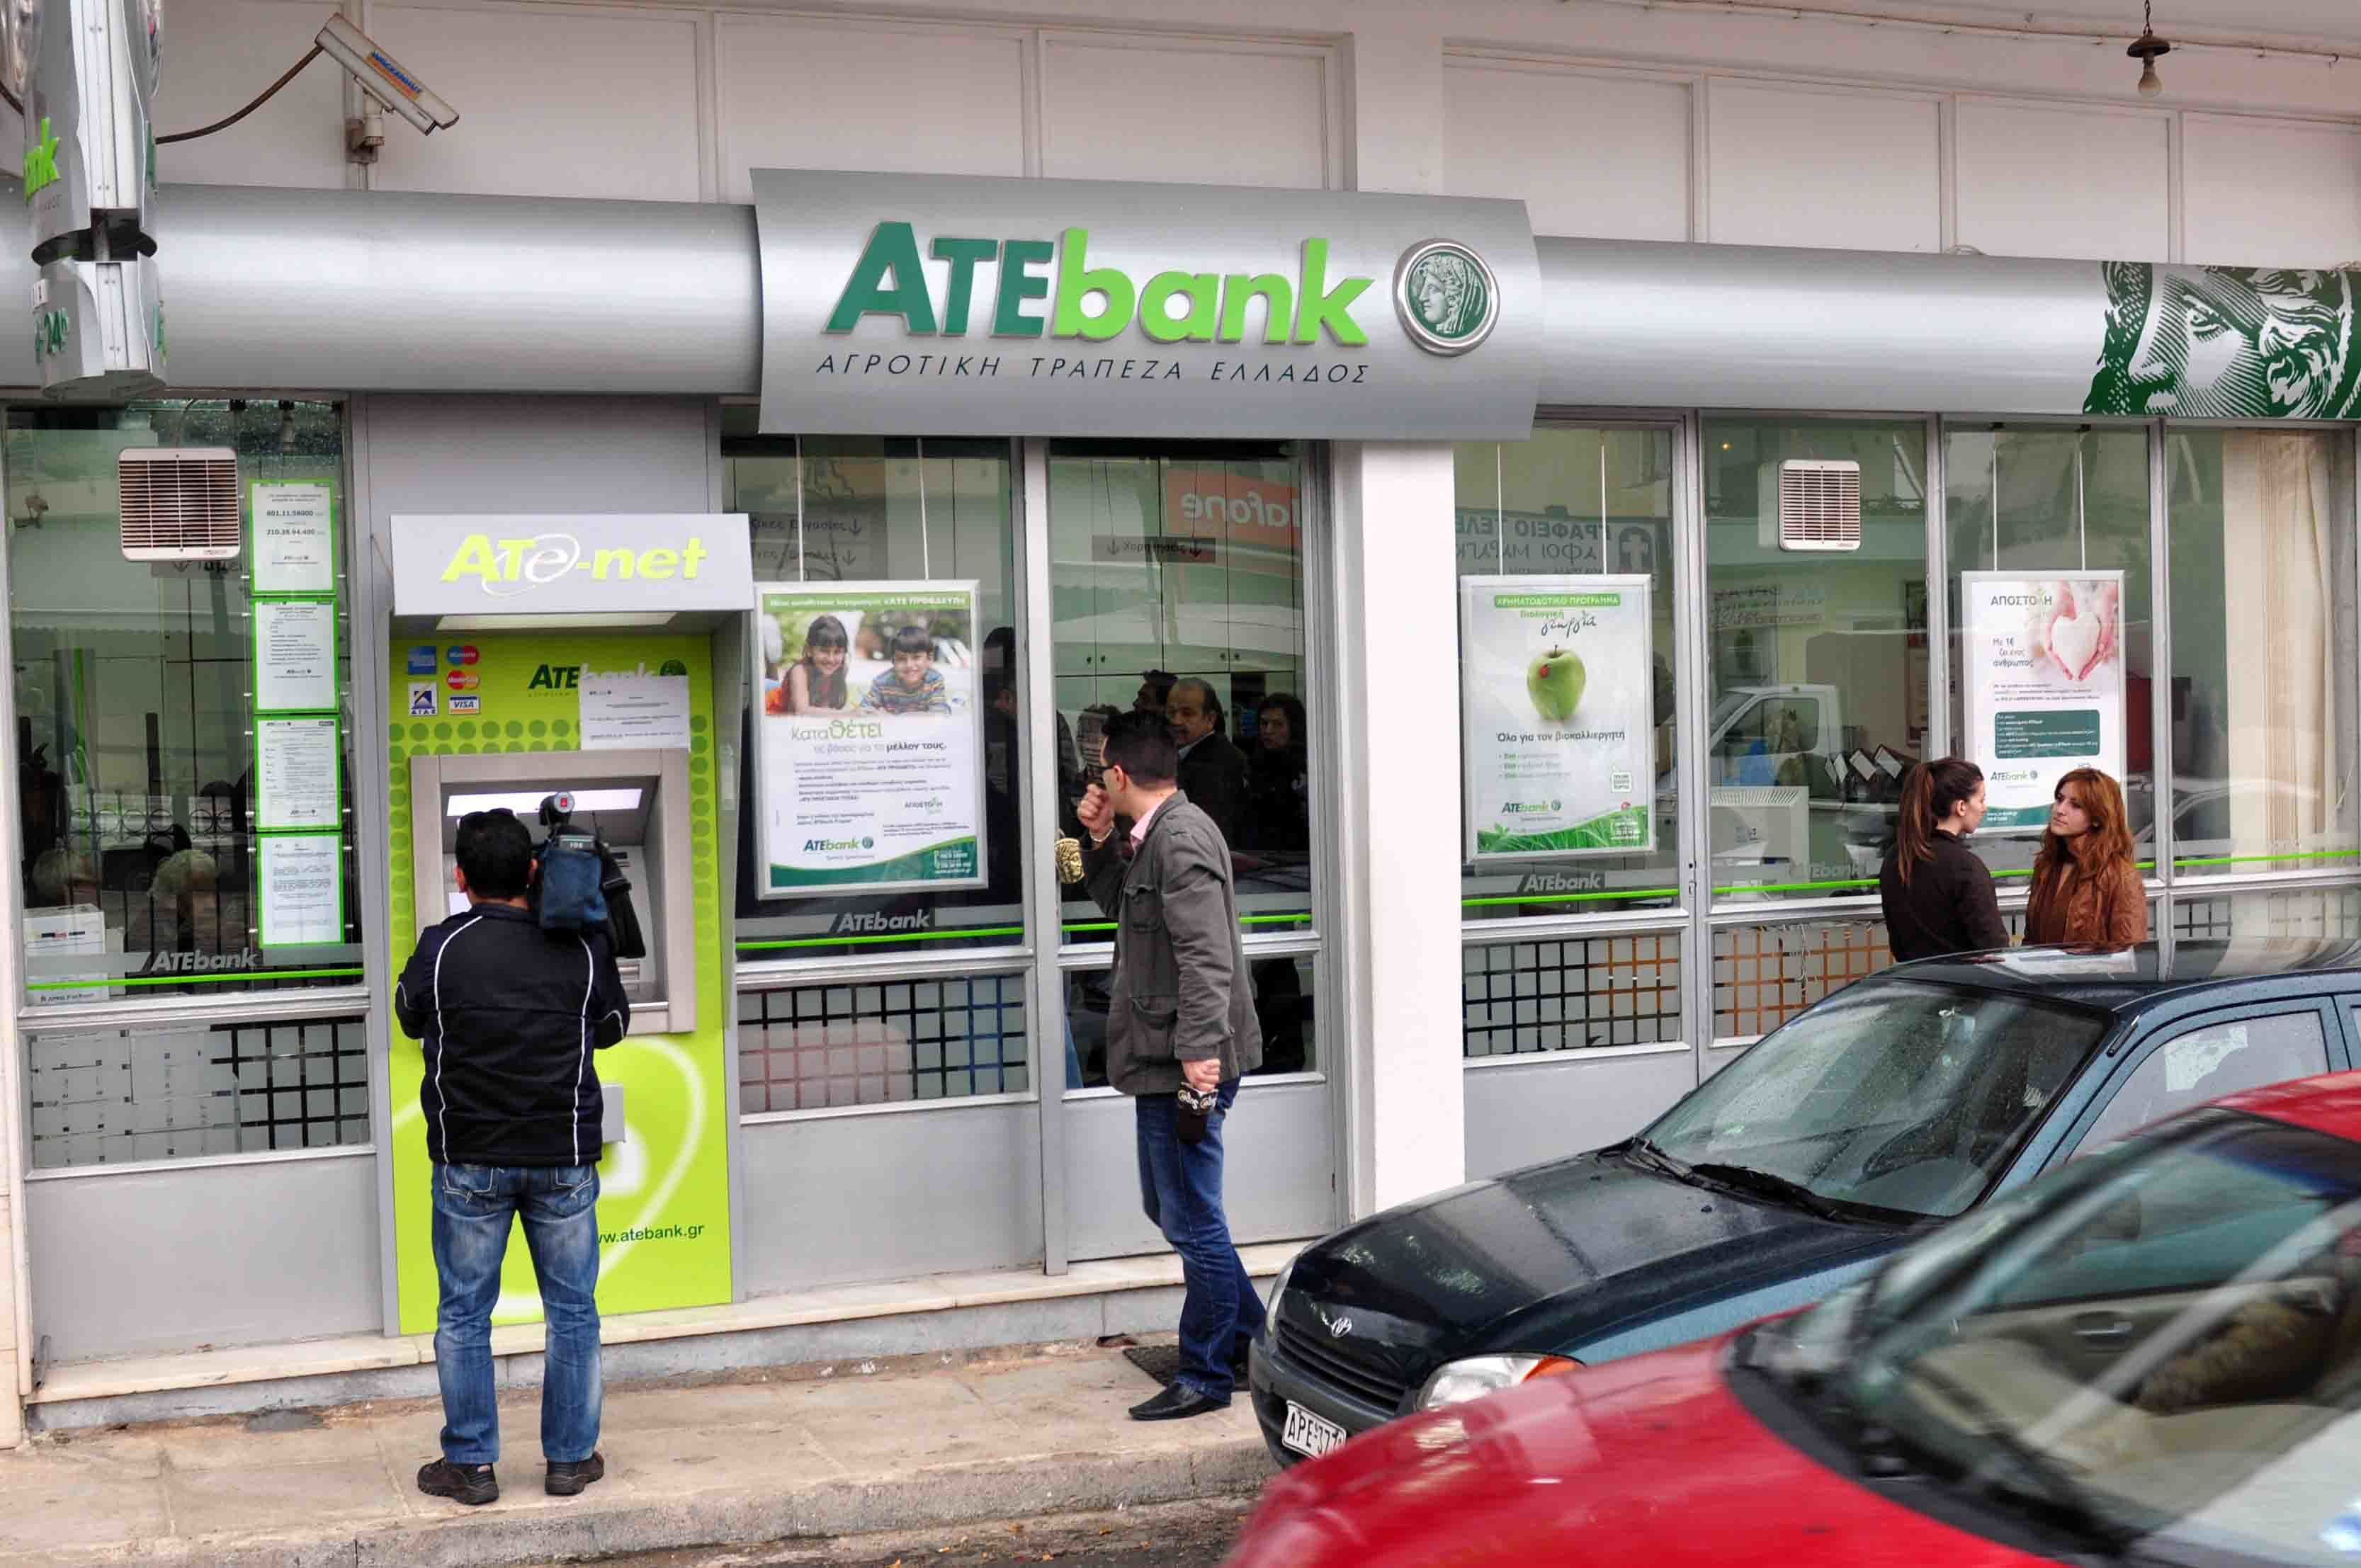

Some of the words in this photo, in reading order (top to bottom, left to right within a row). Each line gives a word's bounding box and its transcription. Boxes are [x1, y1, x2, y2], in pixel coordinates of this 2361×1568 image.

[822, 222, 1374, 346] ATEbank
[816, 353, 1001, 377] ΑΓΡΟΤΙΚΗ
[1030, 356, 1184, 381] ΤΡΑΠΕΖΑ
[1209, 360, 1370, 385] ΕΛΛΑΔΟΣ
[1991, 595, 2052, 606] ΑΠΟΣΤΟΗ
[803, 837, 859, 852] ATEbank
[837, 909, 930, 933] ATEbank
[150, 948, 257, 972] ATEbank
[596, 1225, 705, 1244] ww.atebank.gr
